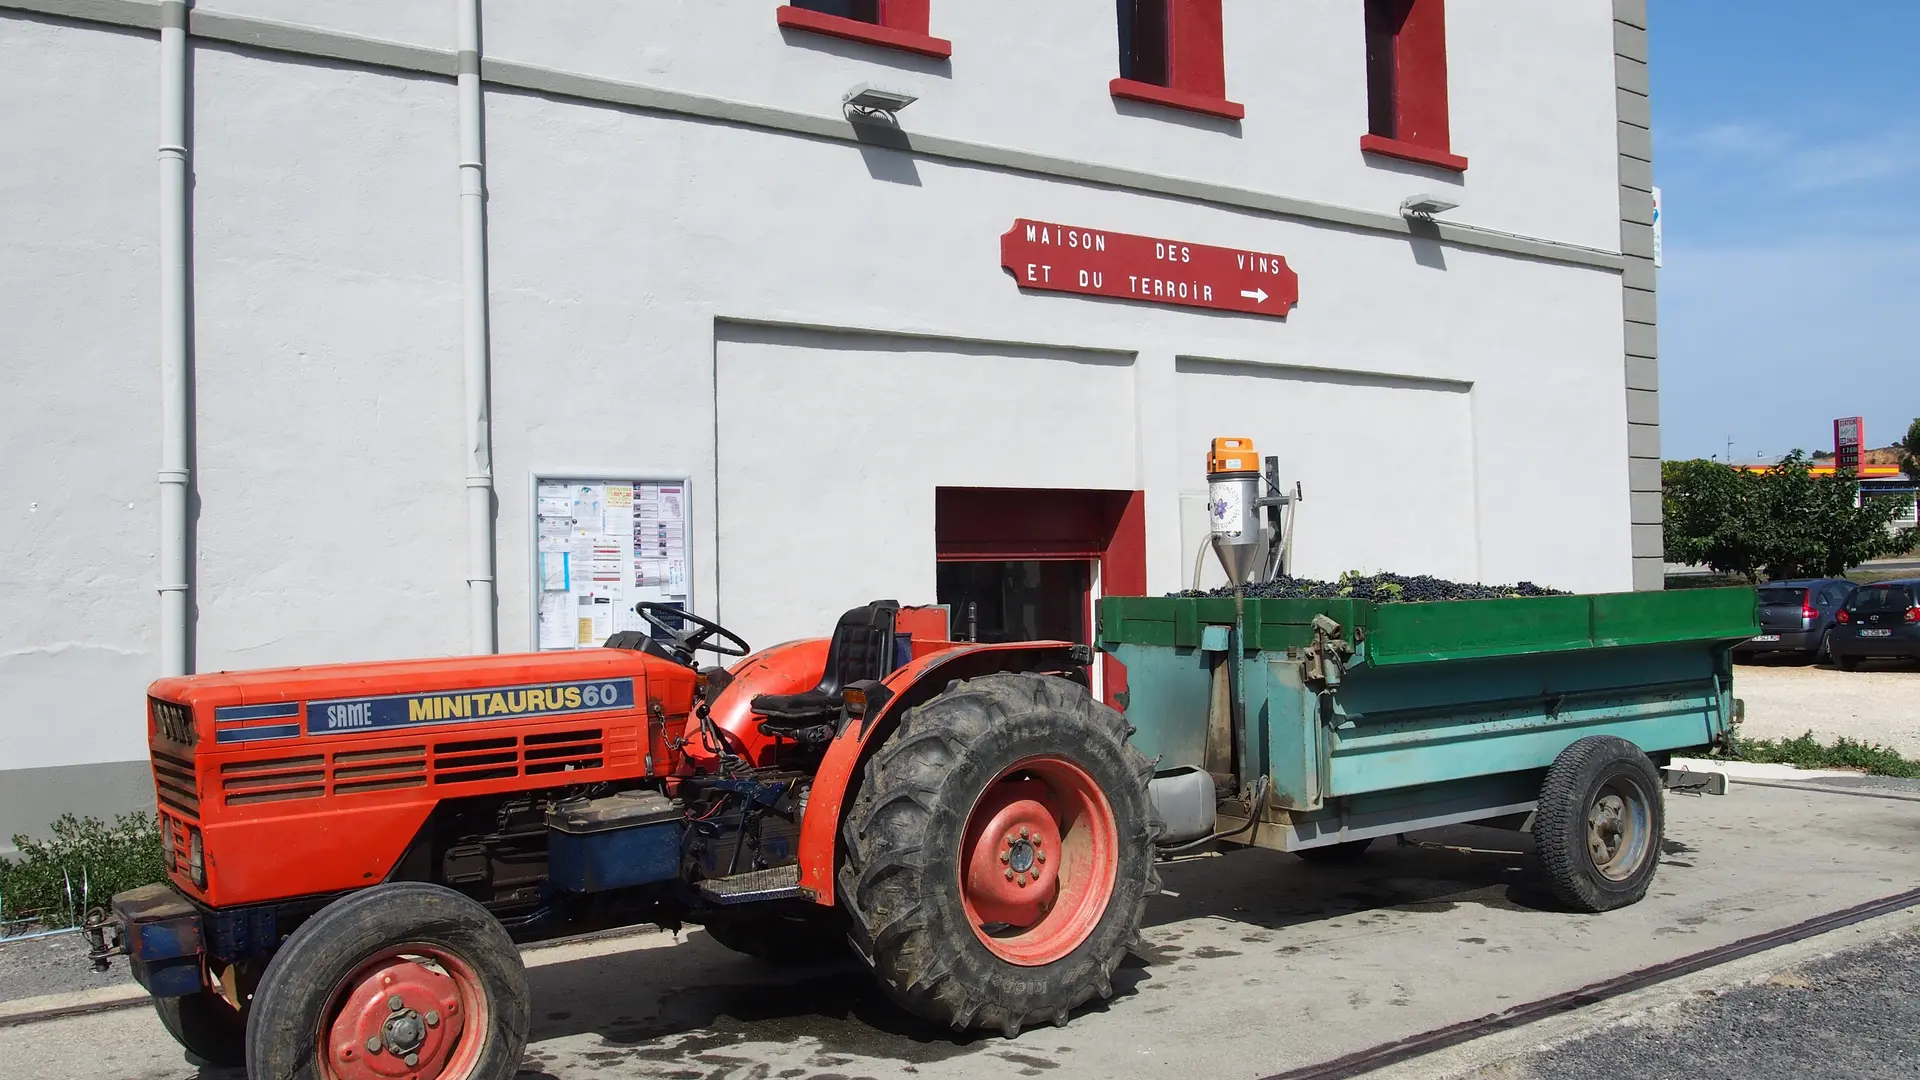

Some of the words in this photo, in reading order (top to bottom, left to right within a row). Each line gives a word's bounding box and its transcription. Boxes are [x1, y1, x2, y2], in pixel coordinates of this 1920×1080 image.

[1156, 242, 1191, 263] DES
[1027, 263, 1052, 283] ET
[1079, 269, 1103, 288] DU
[327, 700, 372, 729] SAME
